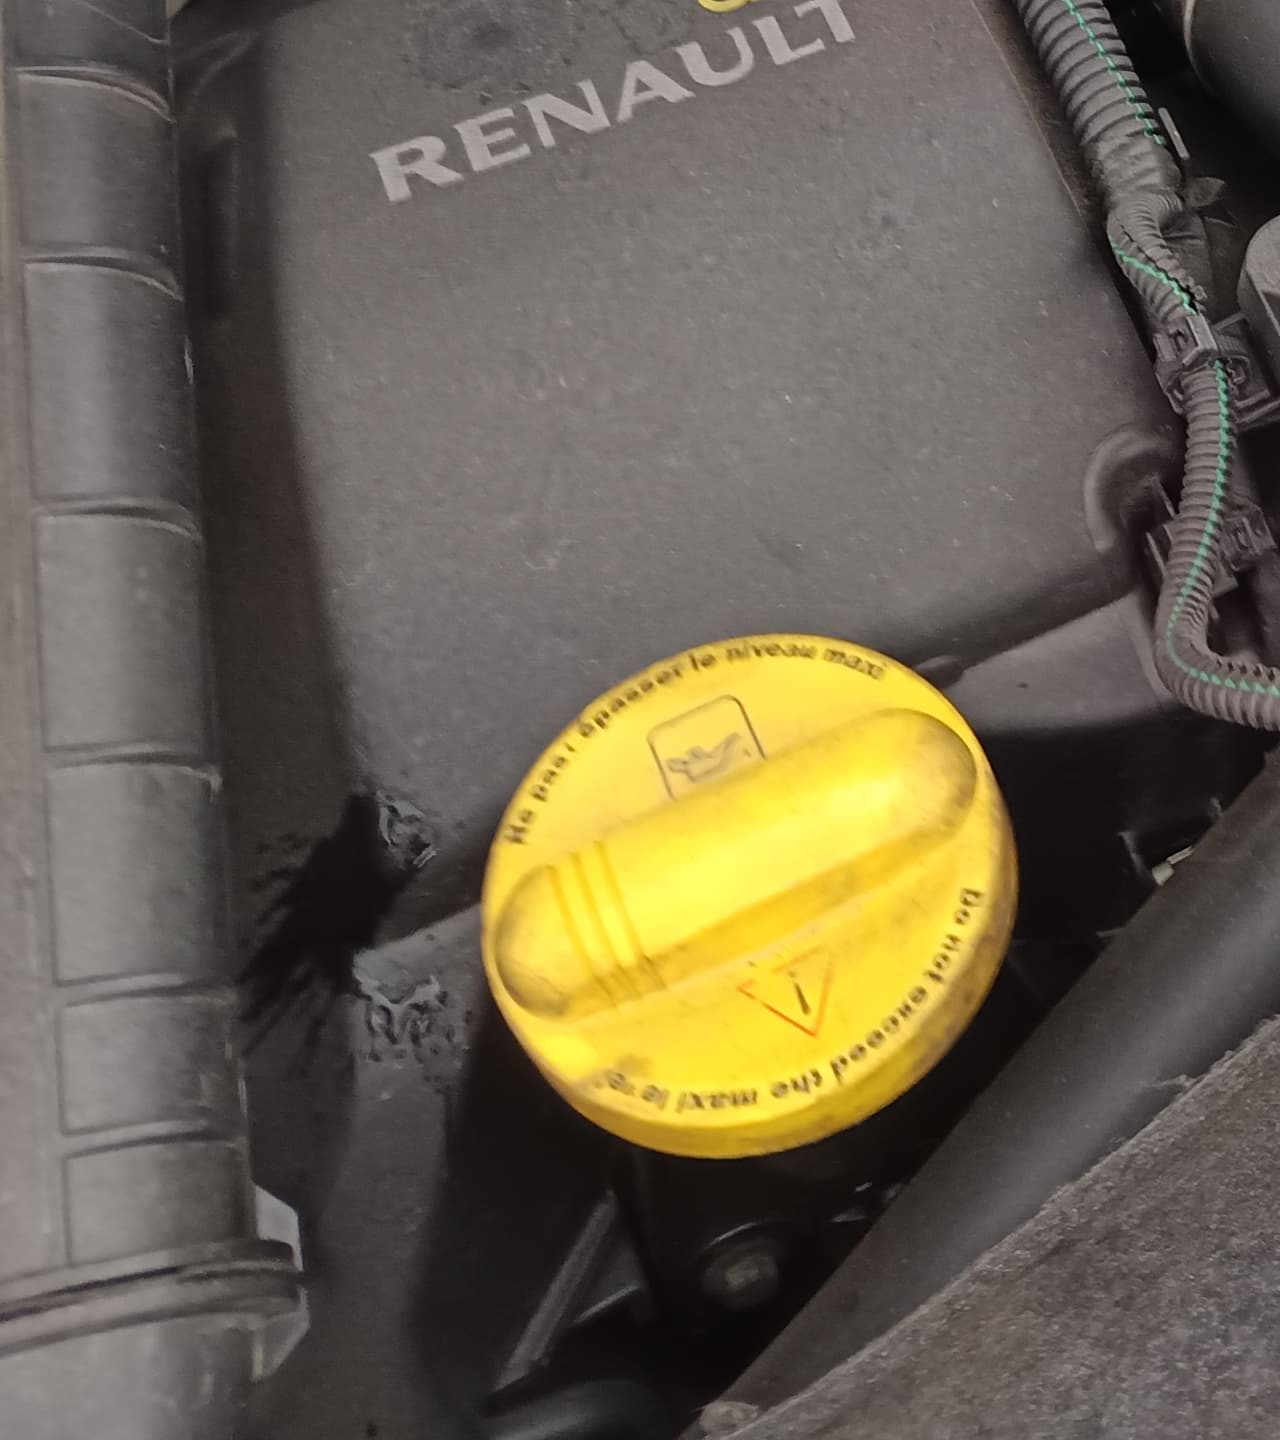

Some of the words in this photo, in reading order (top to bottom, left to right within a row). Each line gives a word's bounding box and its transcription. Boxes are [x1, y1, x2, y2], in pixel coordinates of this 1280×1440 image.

[690, 652, 714, 672] le
[726, 642, 818, 664] niveau
[923, 934, 962, 986] not
[769, 1068, 824, 1097] the
